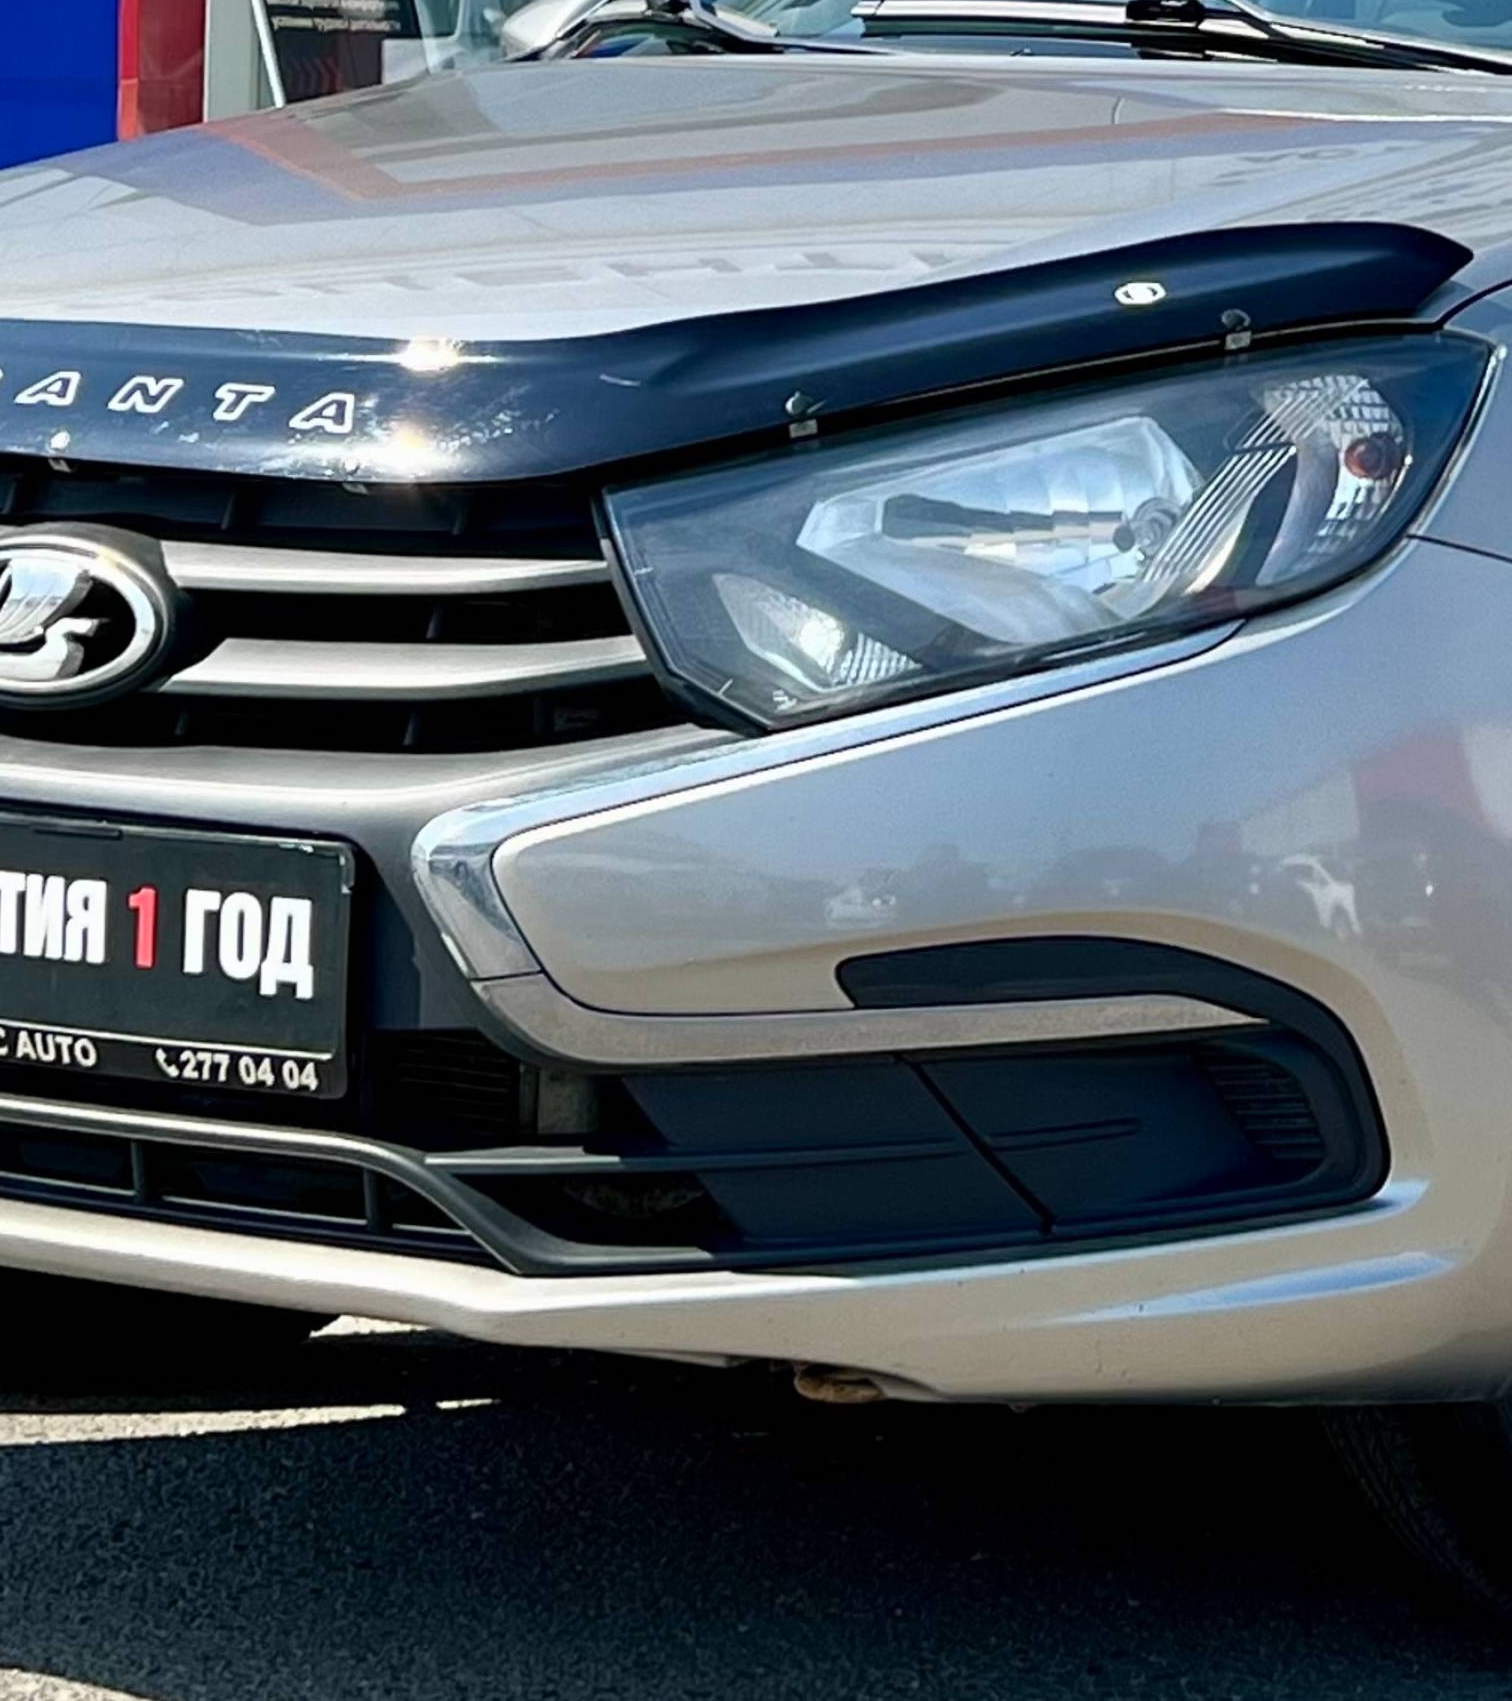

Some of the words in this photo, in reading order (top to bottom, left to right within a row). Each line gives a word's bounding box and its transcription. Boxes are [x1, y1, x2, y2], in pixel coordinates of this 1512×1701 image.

[128, 884, 159, 969] 1
[183, 888, 314, 1000] ГОД
[16, 1032, 98, 1068] AUTO
[178, 1050, 231, 1083] 277
[238, 1054, 276, 1087] 04
[282, 1059, 319, 1092] 04
